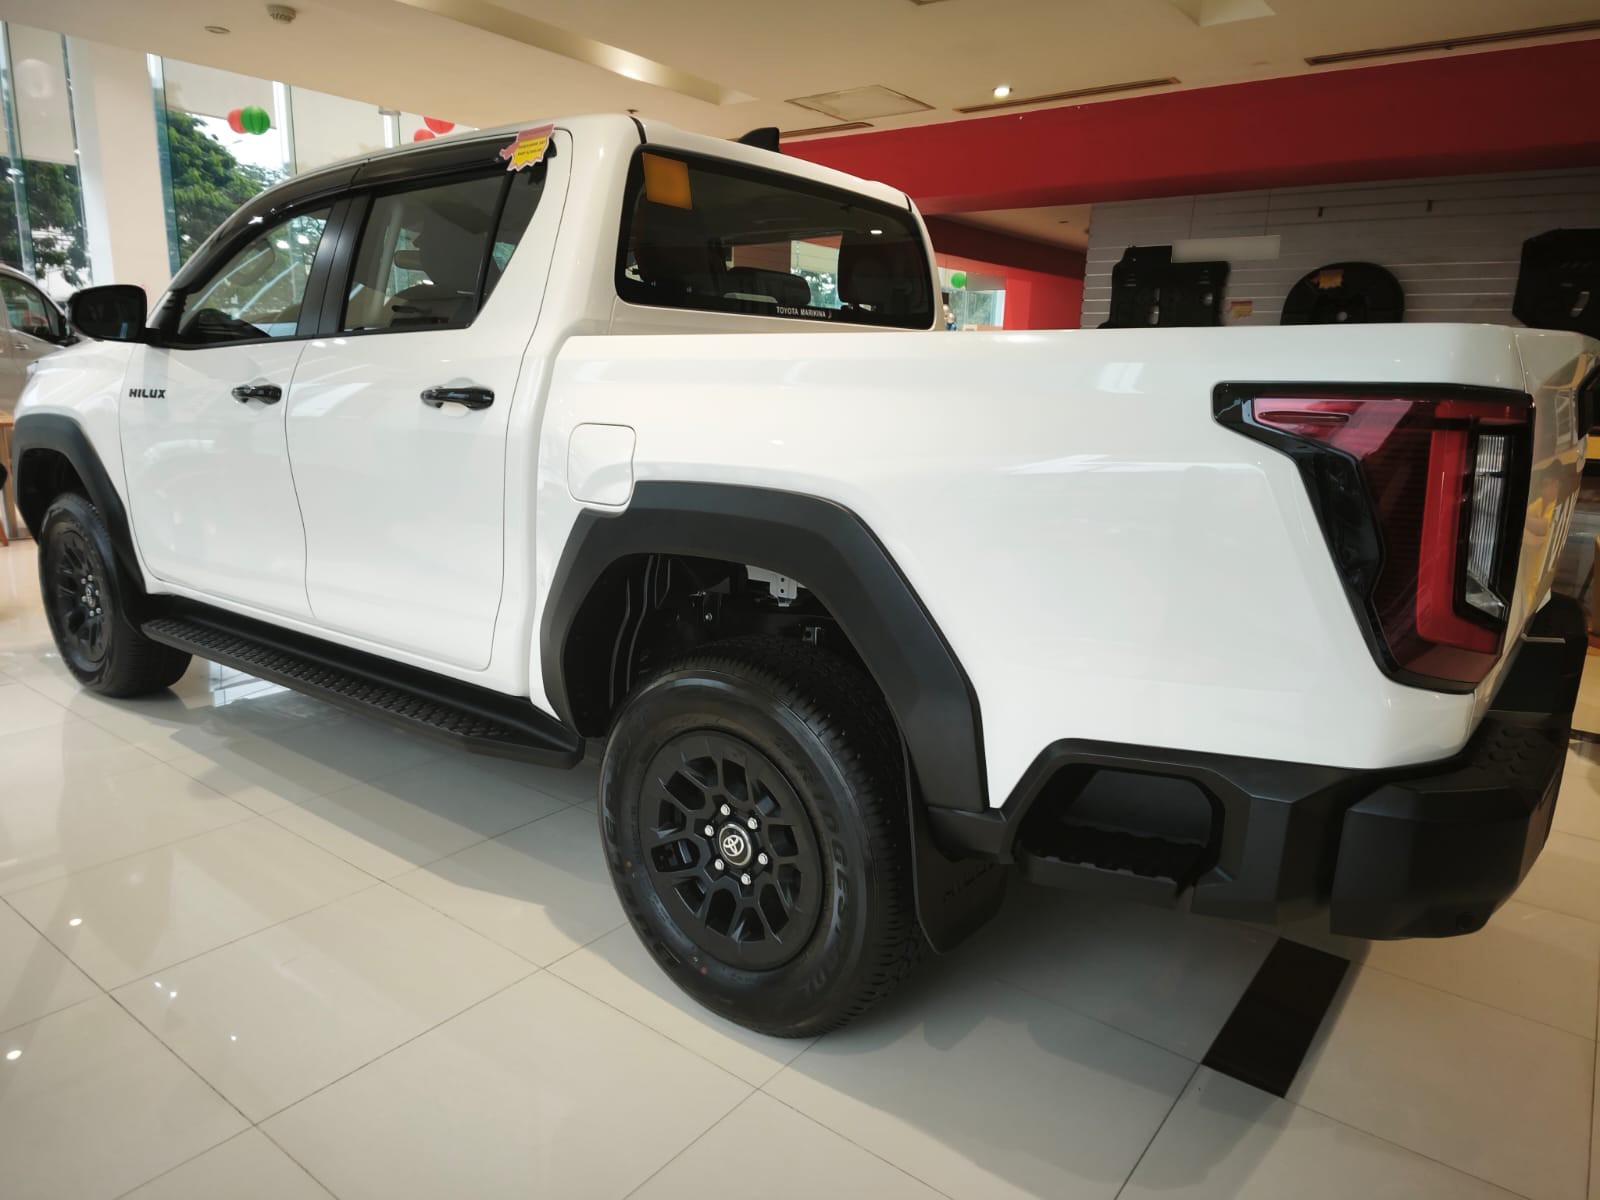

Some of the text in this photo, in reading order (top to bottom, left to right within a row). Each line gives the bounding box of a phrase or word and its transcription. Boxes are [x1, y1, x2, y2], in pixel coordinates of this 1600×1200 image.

[776, 306, 826, 318] TOYOTA MARIKINA
[129, 388, 166, 399] HILUX
